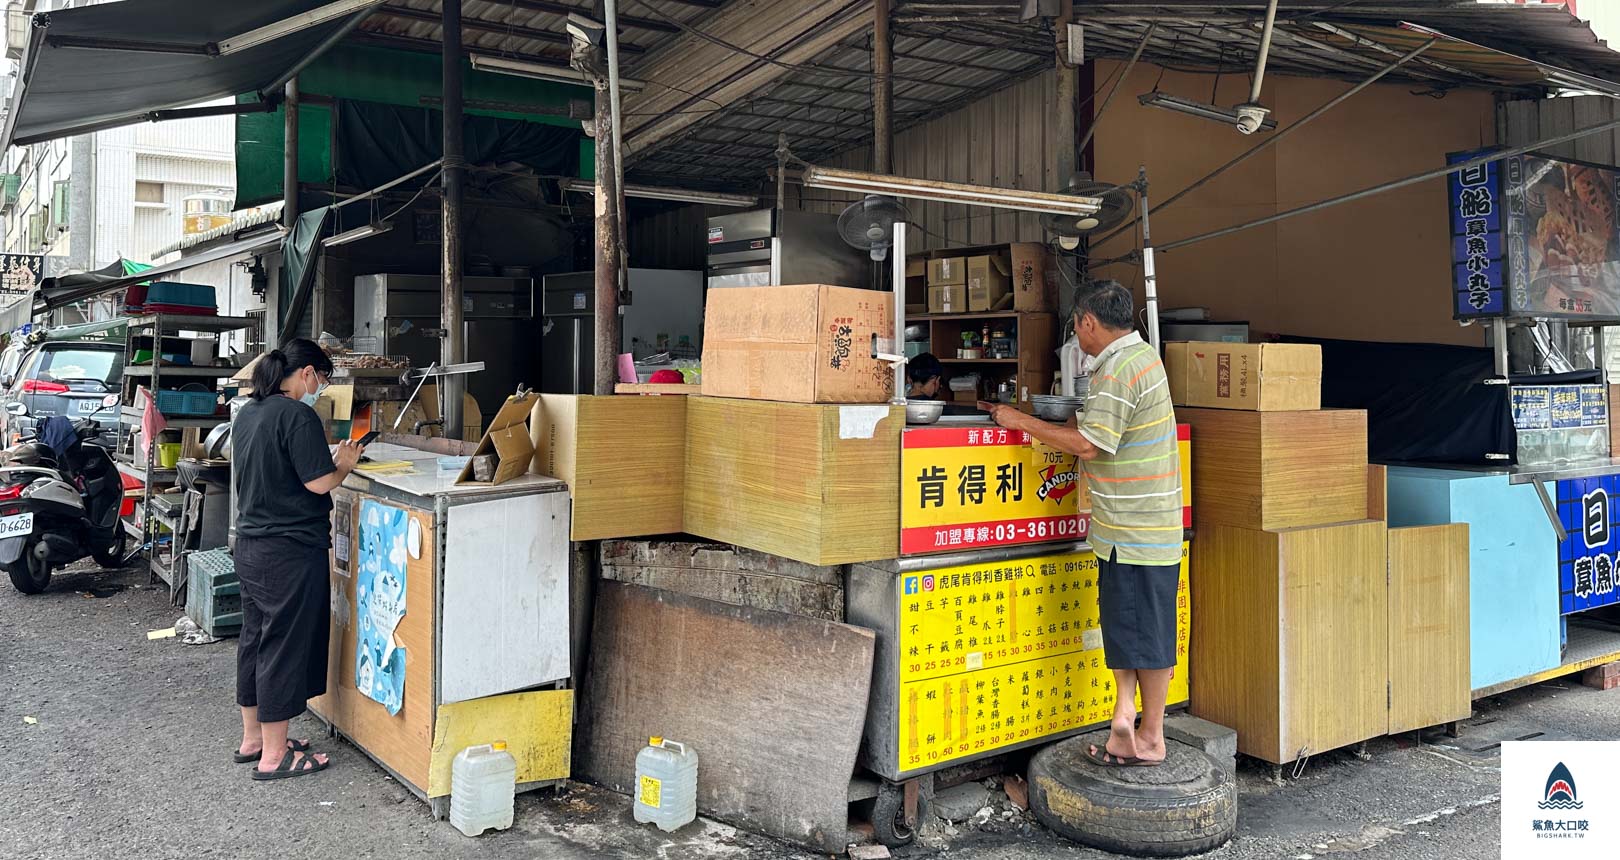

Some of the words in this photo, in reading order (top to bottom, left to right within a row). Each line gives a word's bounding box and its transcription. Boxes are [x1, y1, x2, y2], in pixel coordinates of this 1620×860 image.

[968, 429, 1008, 444] 新配方
[1043, 452, 1064, 464] 70元
[917, 462, 1022, 509] 肯得利
[935, 519, 1090, 547] 加盟專線:03-361020
[1582, 488, 1610, 548] 日
[940, 566, 1023, 590] 虎尾肯得利香雞排
[908, 602, 919, 656] 甜不辣
[925, 600, 934, 654] 豆干
[954, 596, 964, 650] 百頁豆腐
[1022, 588, 1032, 636] 雞心
[1048, 584, 1057, 634] 香菇
[1060, 583, 1070, 632] 杏鮑菇
[1177, 579, 1187, 657] 非固定店休
[909, 664, 920, 672] 30
[924, 662, 936, 670] 25
[940, 659, 951, 668] 25
[954, 656, 966, 666] 20
[984, 652, 993, 660] 15
[996, 650, 1007, 658] 15
[1010, 647, 1020, 656] 30
[1023, 644, 1032, 653] 30
[1036, 642, 1045, 651] 35
[1048, 640, 1058, 648] 30
[1073, 636, 1082, 644] 65
[990, 677, 1000, 720] 台灣香腸
[1005, 674, 1015, 726] 米腸
[1049, 666, 1058, 717] 小肉豆
[1063, 662, 1072, 713] 麥克雞塊
[909, 755, 920, 764] 35
[926, 751, 938, 760] 10
[943, 747, 953, 756] 50
[959, 743, 969, 752] 50
[974, 740, 984, 748] 25
[990, 736, 1000, 745] 30
[1005, 732, 1015, 741] 20
[1020, 729, 1029, 737] 20
[1035, 725, 1043, 733] 13
[1048, 722, 1057, 730] 30
[1089, 712, 1098, 720] 25
[1102, 709, 1111, 717] 35
